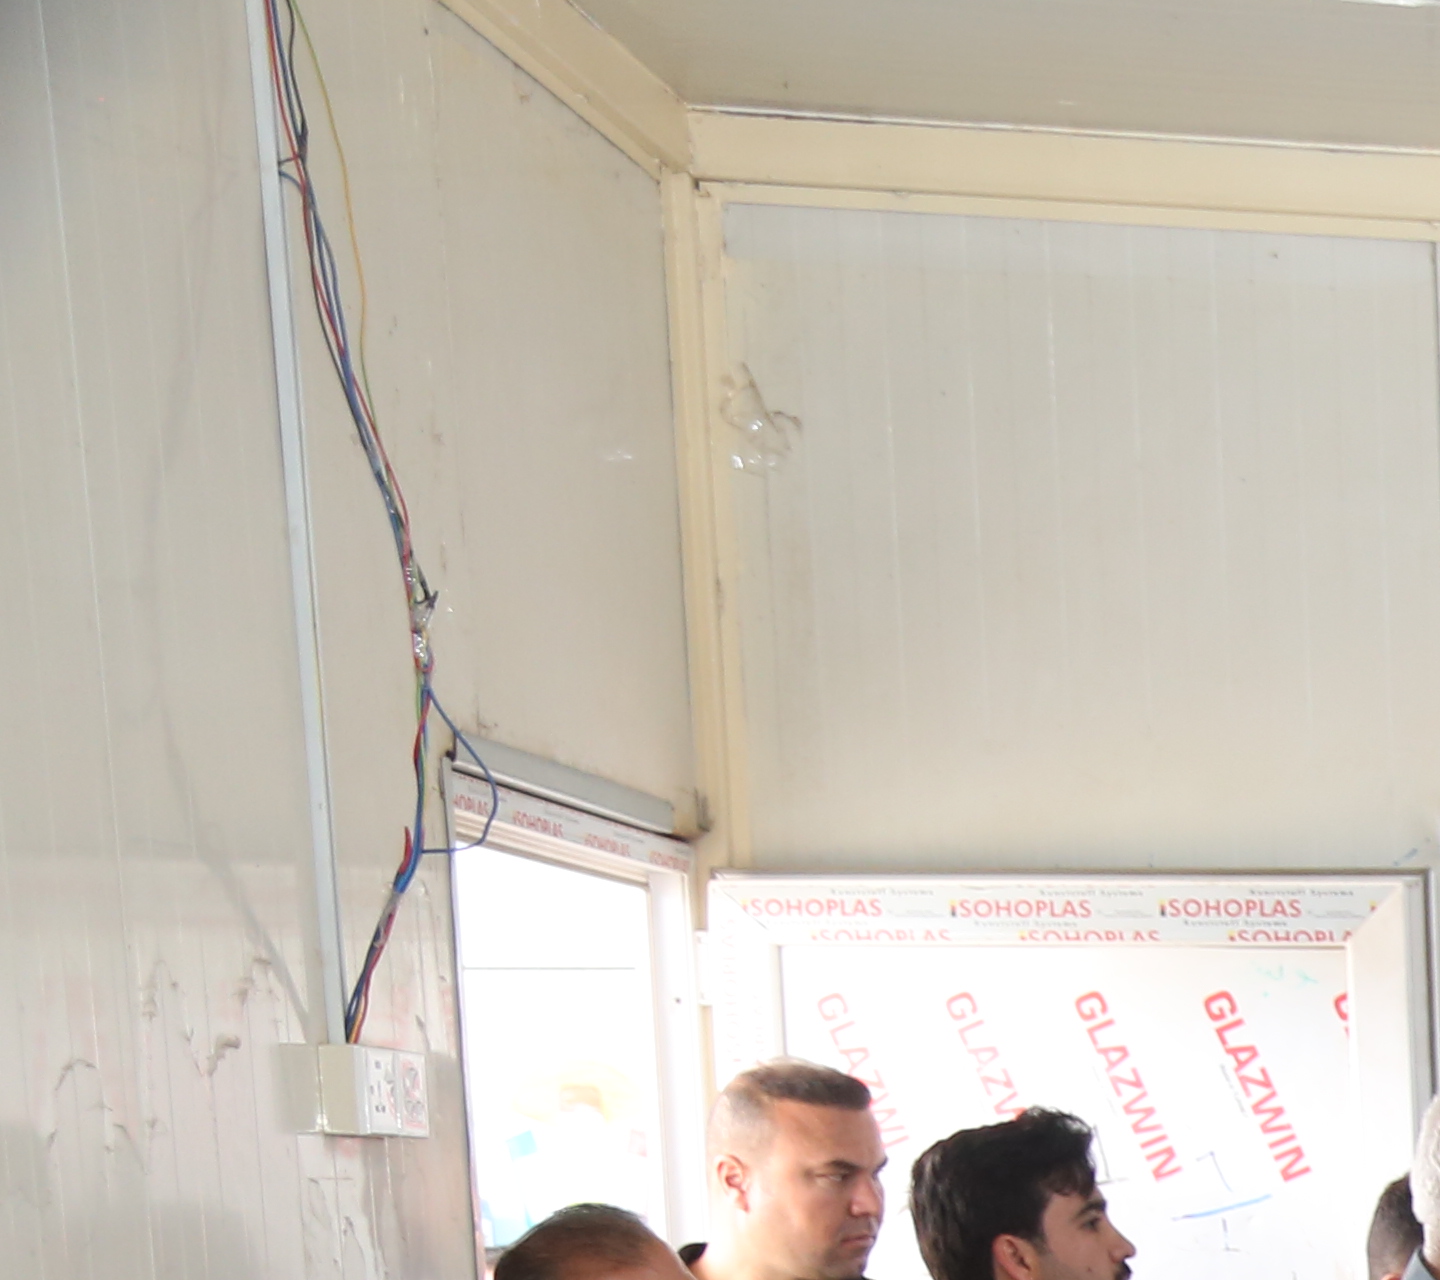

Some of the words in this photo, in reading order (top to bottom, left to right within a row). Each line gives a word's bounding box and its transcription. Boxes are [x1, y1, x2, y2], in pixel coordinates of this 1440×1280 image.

[945, 991, 1028, 1122] GLAZW
[1074, 989, 1182, 1182] GLAZWIN
[1203, 989, 1311, 1183] GLAZWIN
